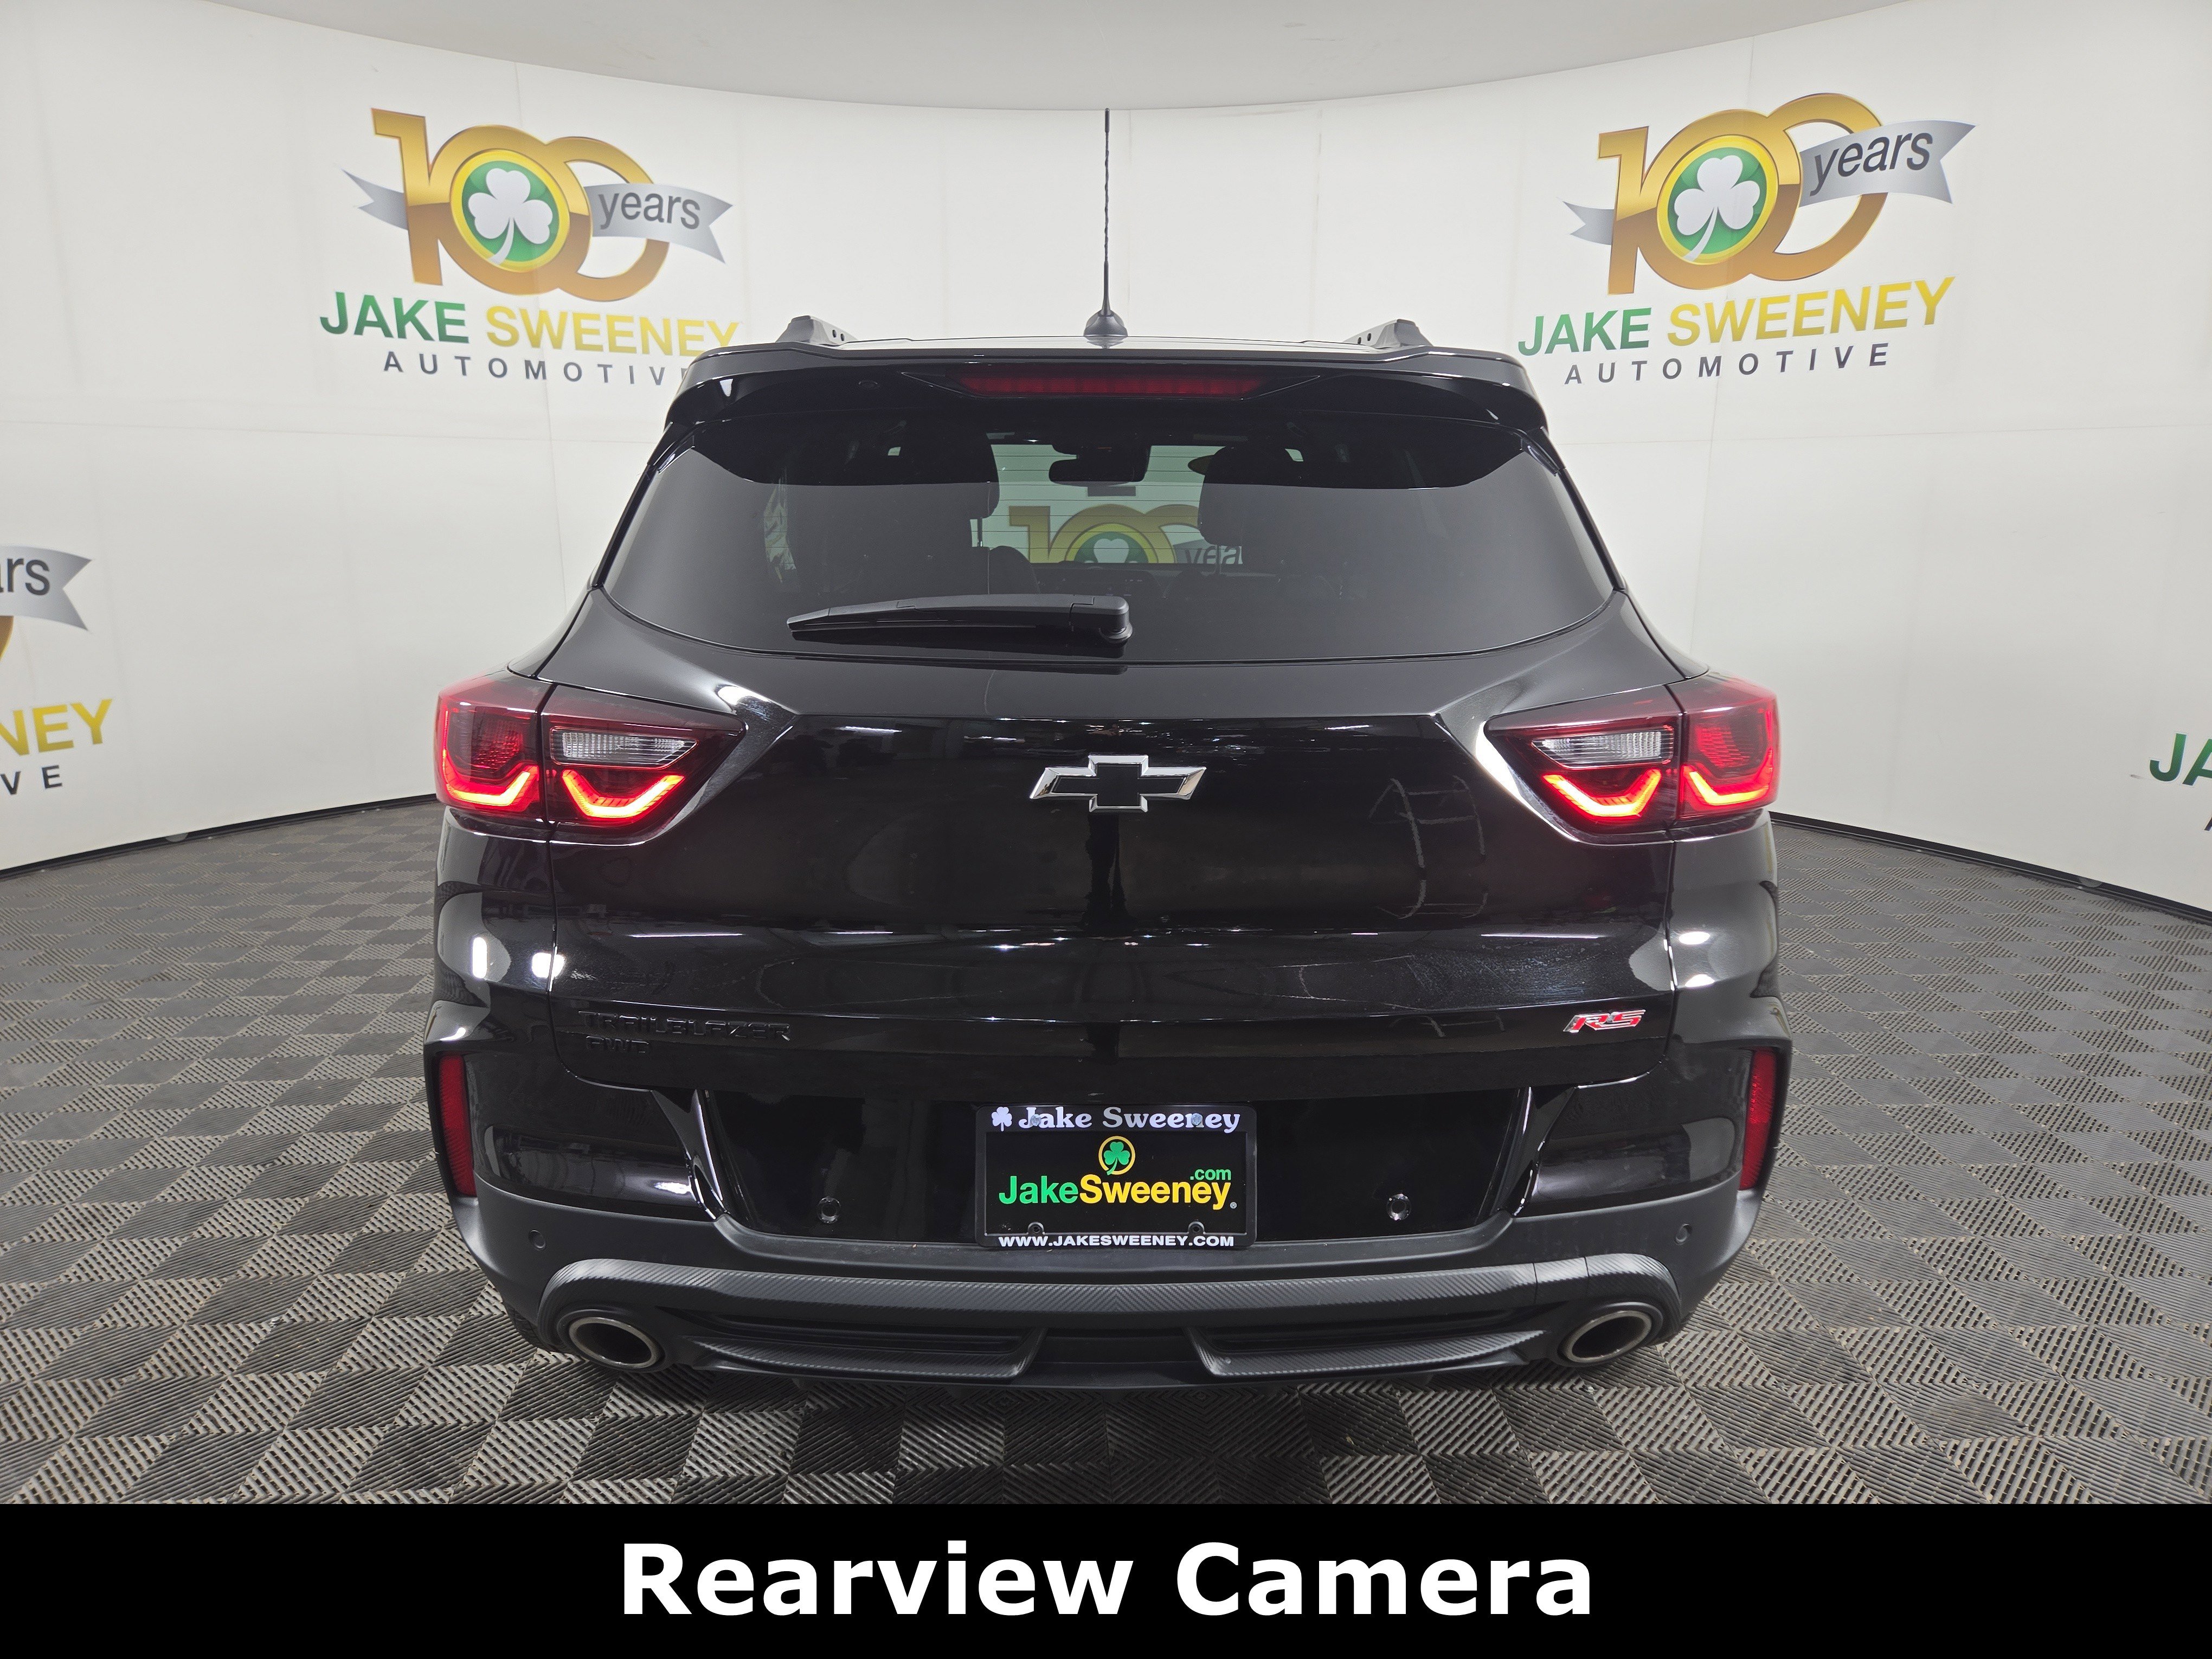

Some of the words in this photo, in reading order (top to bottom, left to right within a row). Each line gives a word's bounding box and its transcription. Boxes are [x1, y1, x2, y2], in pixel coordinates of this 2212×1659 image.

[1809, 132, 1933, 197] years
[372, 108, 670, 302] 100
[598, 191, 701, 230] years
[1597, 92, 1888, 294] 100
[320, 291, 470, 343] JAKE
[486, 305, 740, 357] SWEENEY
[1517, 307, 1652, 356] JAKE
[1668, 276, 1956, 346] SWEENEY
[383, 350, 688, 385] AUTOMOTIV
[1564, 343, 1889, 385] AUTOMOTIVE
[1562, 1009, 1646, 1033] RS
[1018, 1107, 1092, 1129] Jake
[1102, 1107, 1240, 1133] Sweeney
[999, 1174, 1231, 1210] JakeSweeney
[998, 1235, 1234, 1247] WWW.JAKESWEENEY.COM
